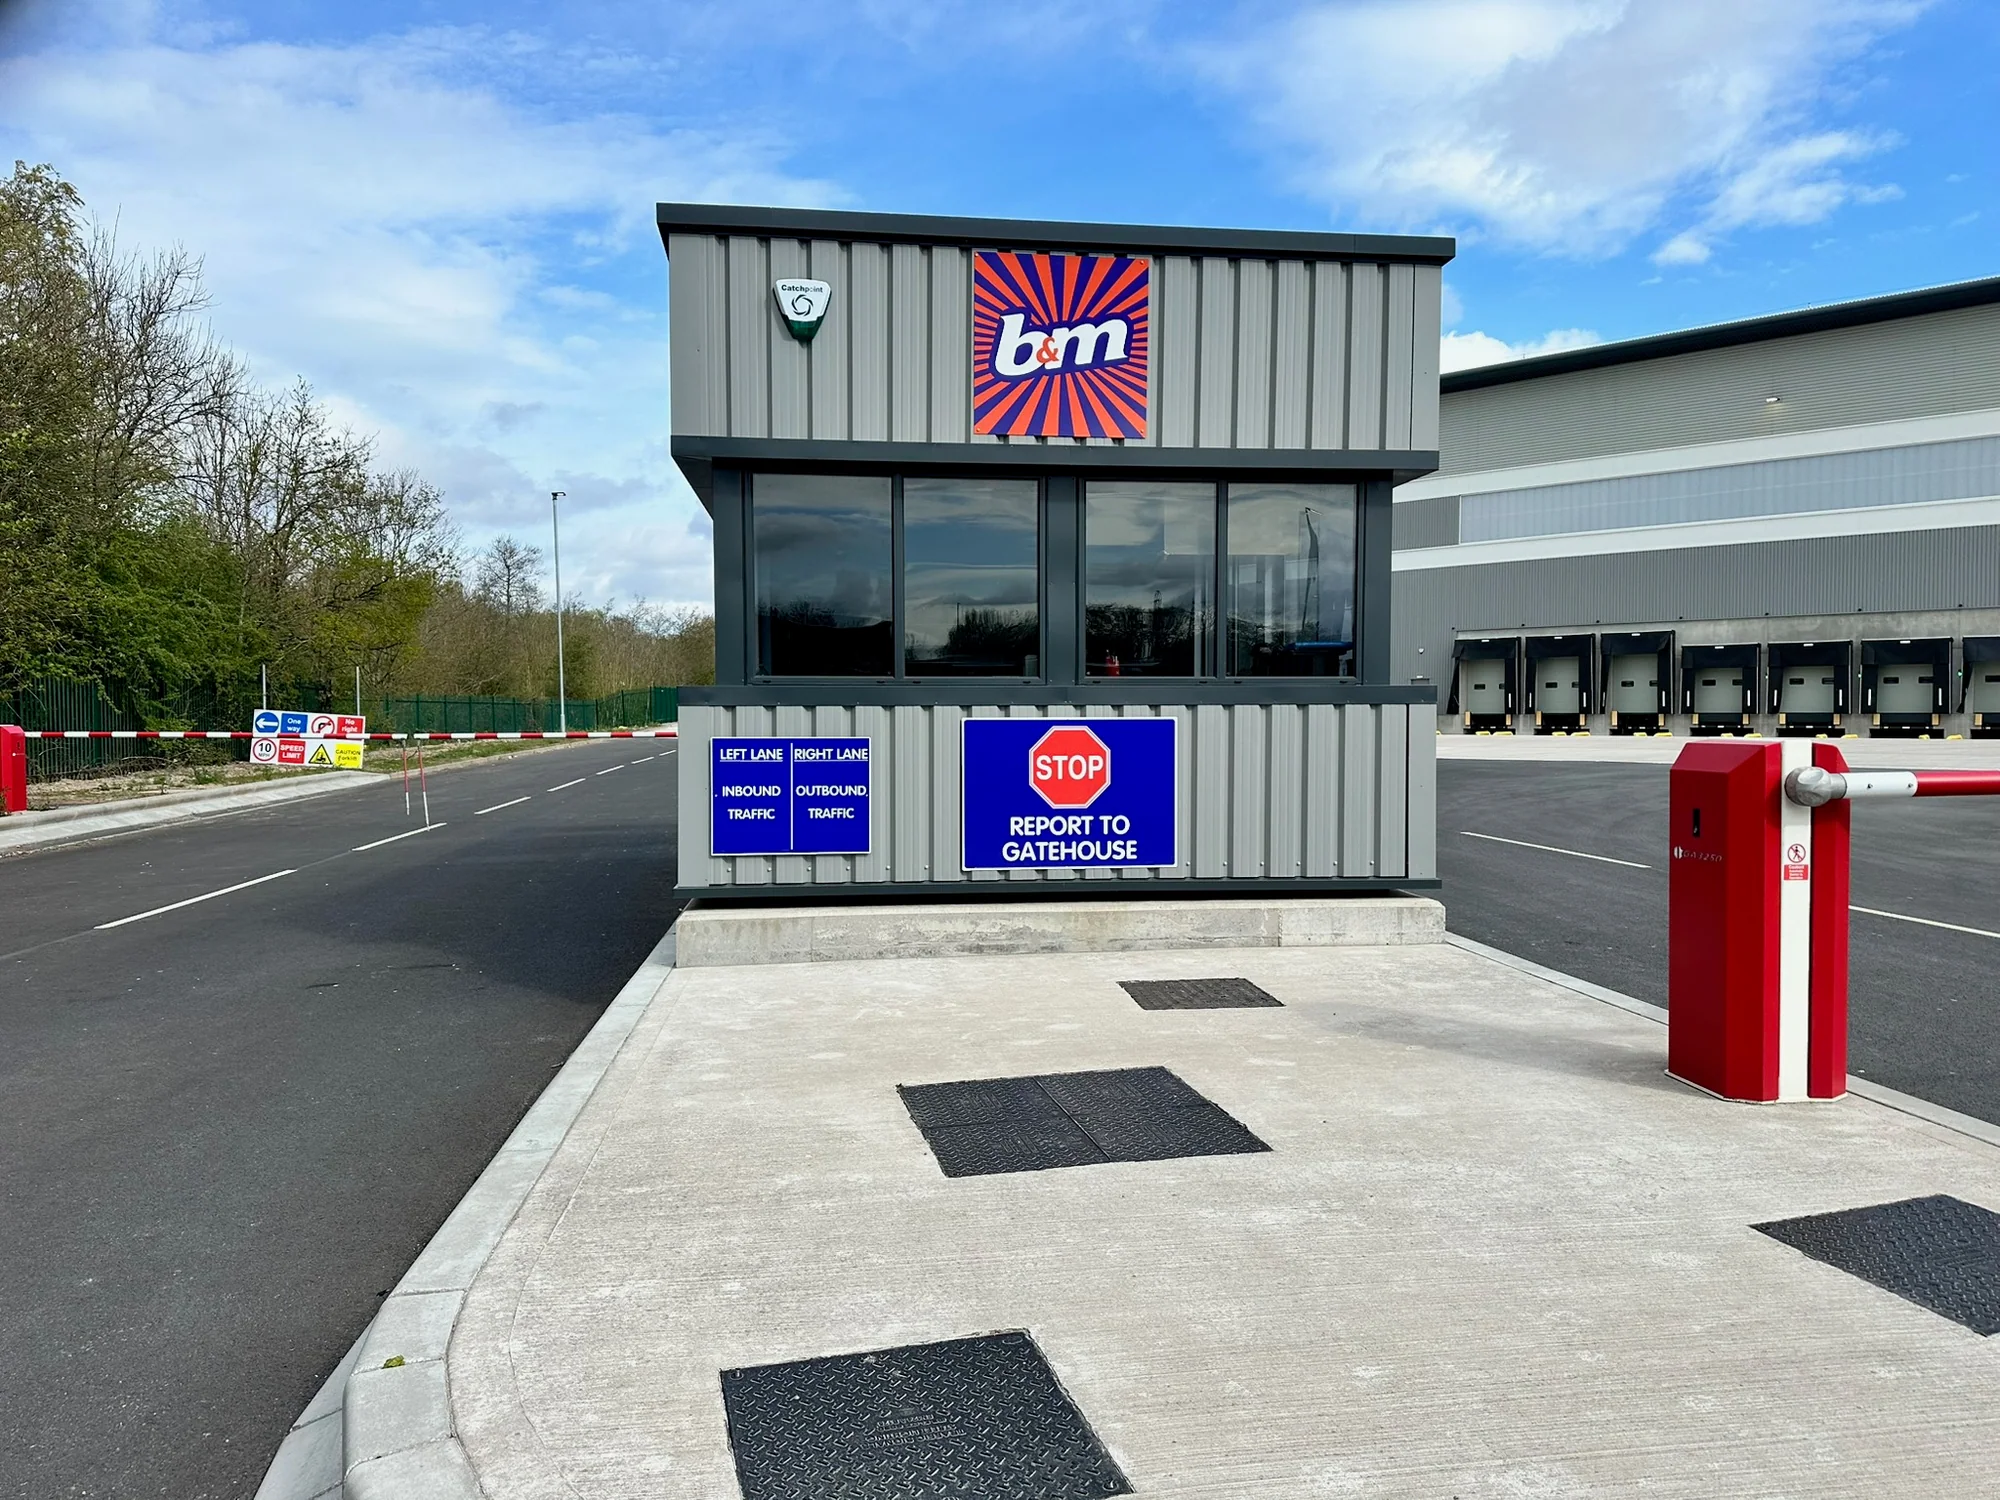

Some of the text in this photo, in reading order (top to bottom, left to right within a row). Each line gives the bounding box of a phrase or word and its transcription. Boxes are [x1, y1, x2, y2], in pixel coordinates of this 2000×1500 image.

[781, 284, 823, 293] Catchpoint
[995, 313, 1128, 376] b&m
[287, 725, 300, 733] way
[341, 725, 358, 733] right
[258, 742, 271, 753] 10
[280, 744, 304, 752] SPEED
[720, 748, 783, 760] LEFT LANE
[794, 748, 868, 760] RIGHT LANE
[1036, 755, 1104, 780] STOP
[722, 785, 781, 797] INBOUND
[795, 785, 867, 797] OUTBOUND
[727, 808, 775, 820] TRAFFIC
[808, 807, 855, 819] TRAFFIC
[1010, 815, 1130, 836] REPORT TO
[1002, 840, 1138, 861] GATEHOUSE
